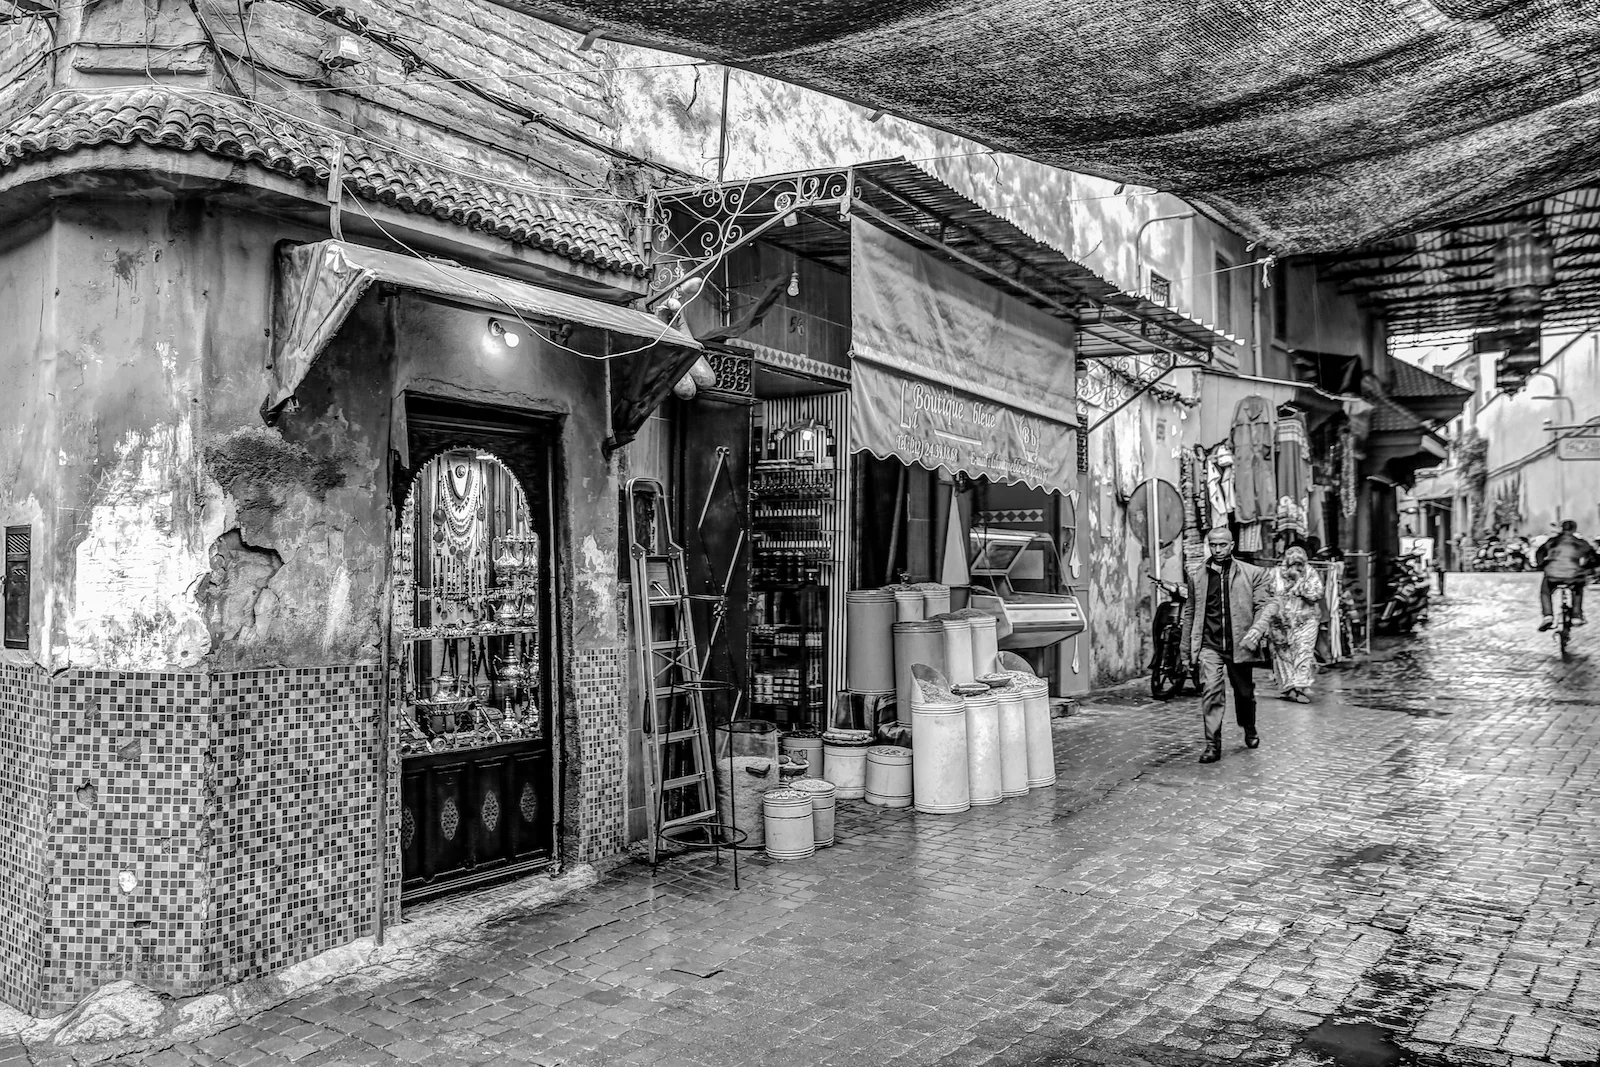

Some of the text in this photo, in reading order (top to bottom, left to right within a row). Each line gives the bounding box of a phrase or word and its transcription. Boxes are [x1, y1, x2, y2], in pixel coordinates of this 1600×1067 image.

[789, 316, 805, 336] 56
[900, 379, 996, 429] La Boutique bleue
